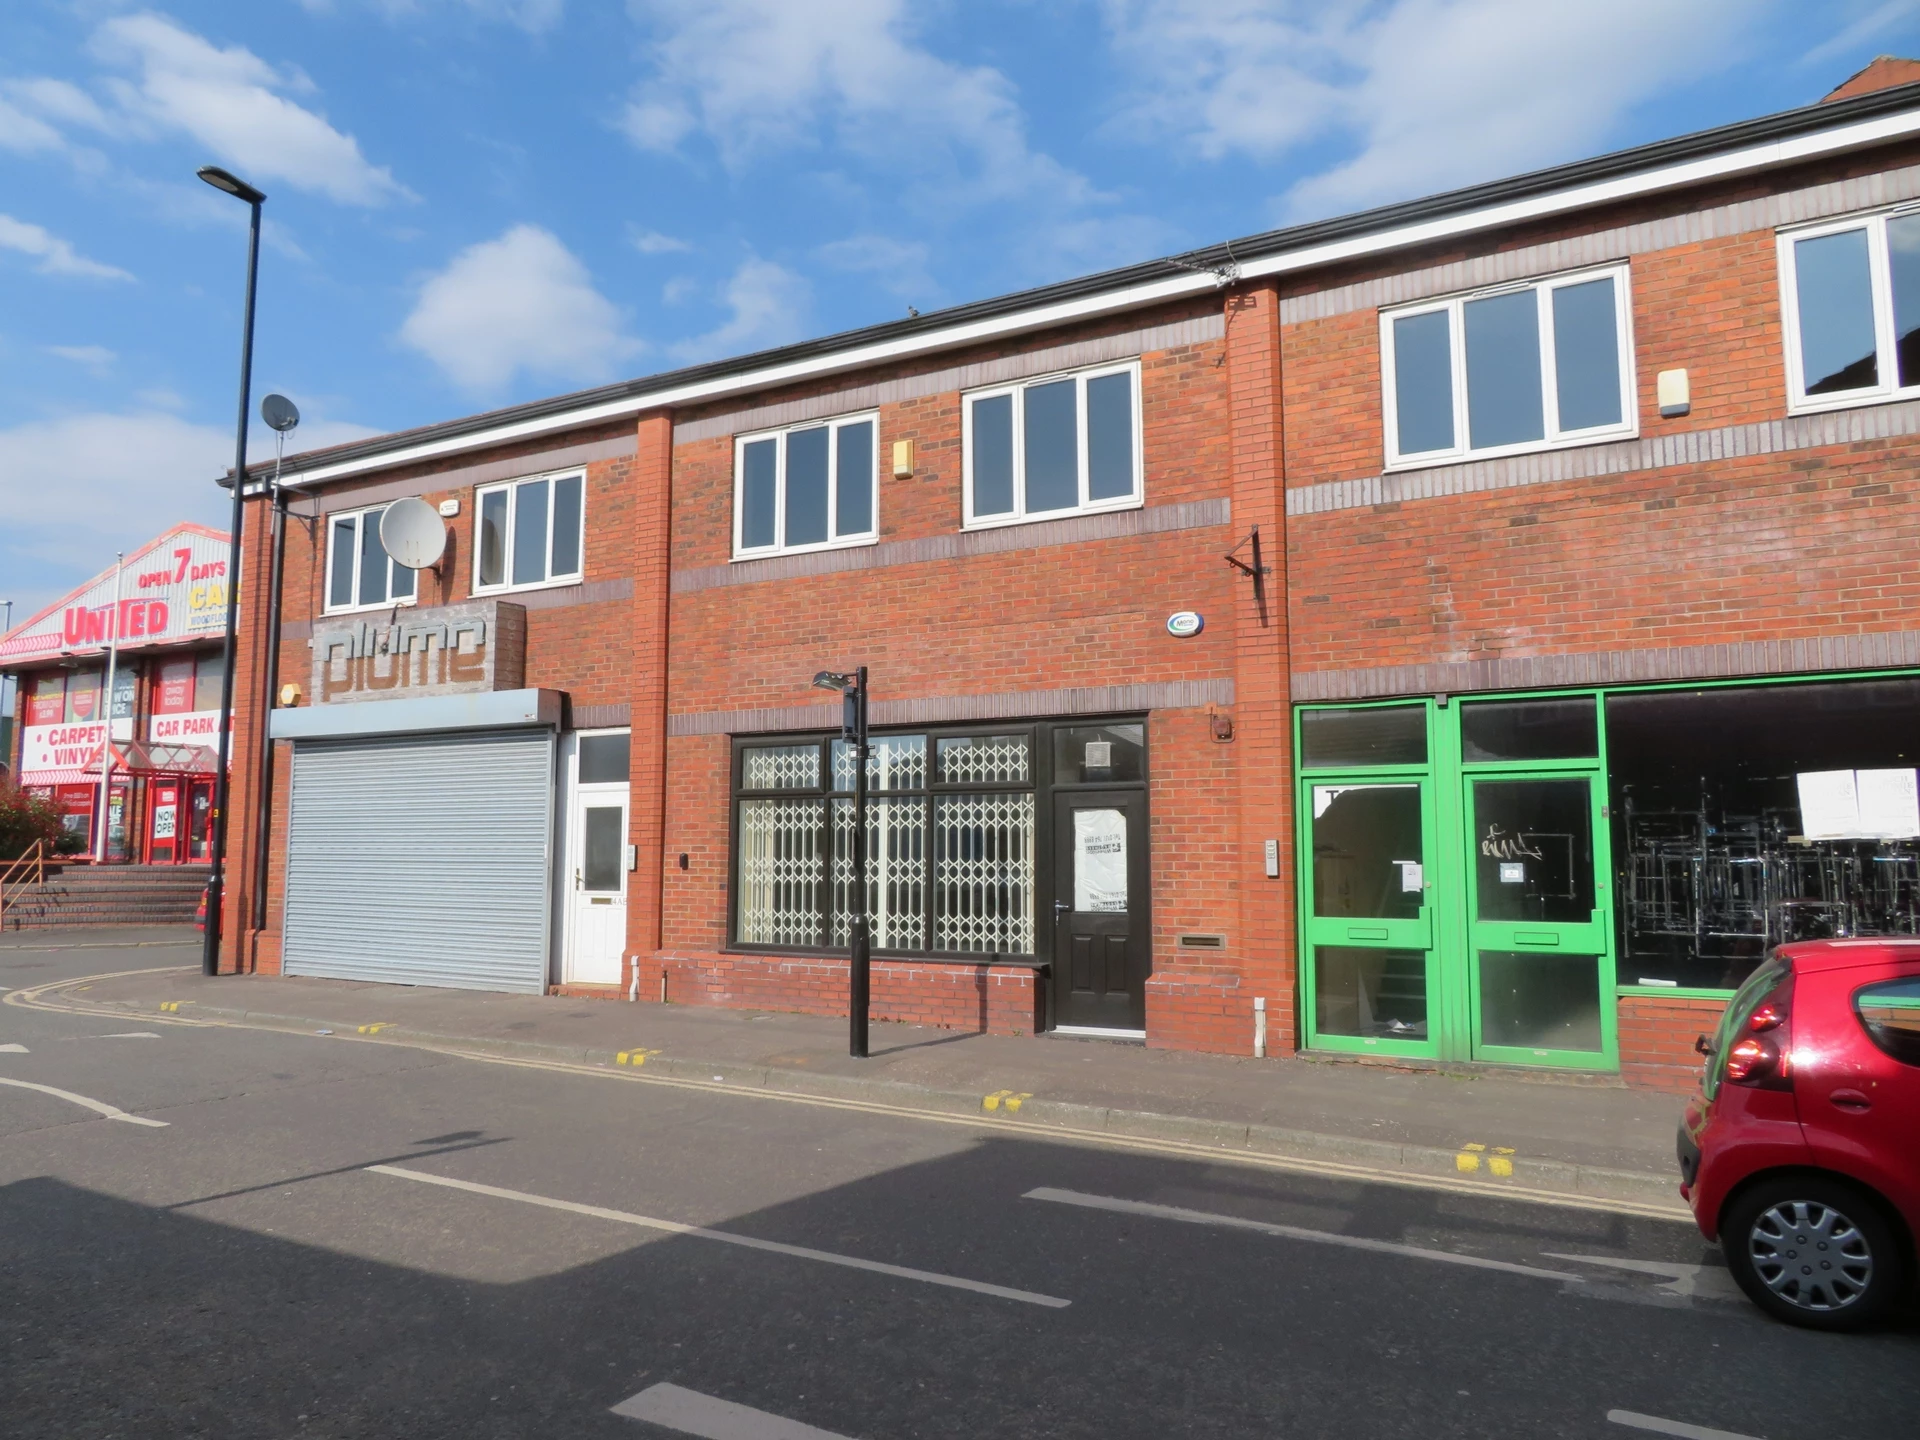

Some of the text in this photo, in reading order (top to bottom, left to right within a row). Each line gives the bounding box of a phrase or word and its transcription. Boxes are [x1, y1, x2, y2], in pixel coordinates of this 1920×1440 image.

[138, 547, 226, 588] OPEN 7 DAYS
[64, 598, 169, 645] UNITED
[49, 724, 114, 746] CARPETS
[157, 720, 179, 737] CAR
[183, 717, 215, 735] PARK
